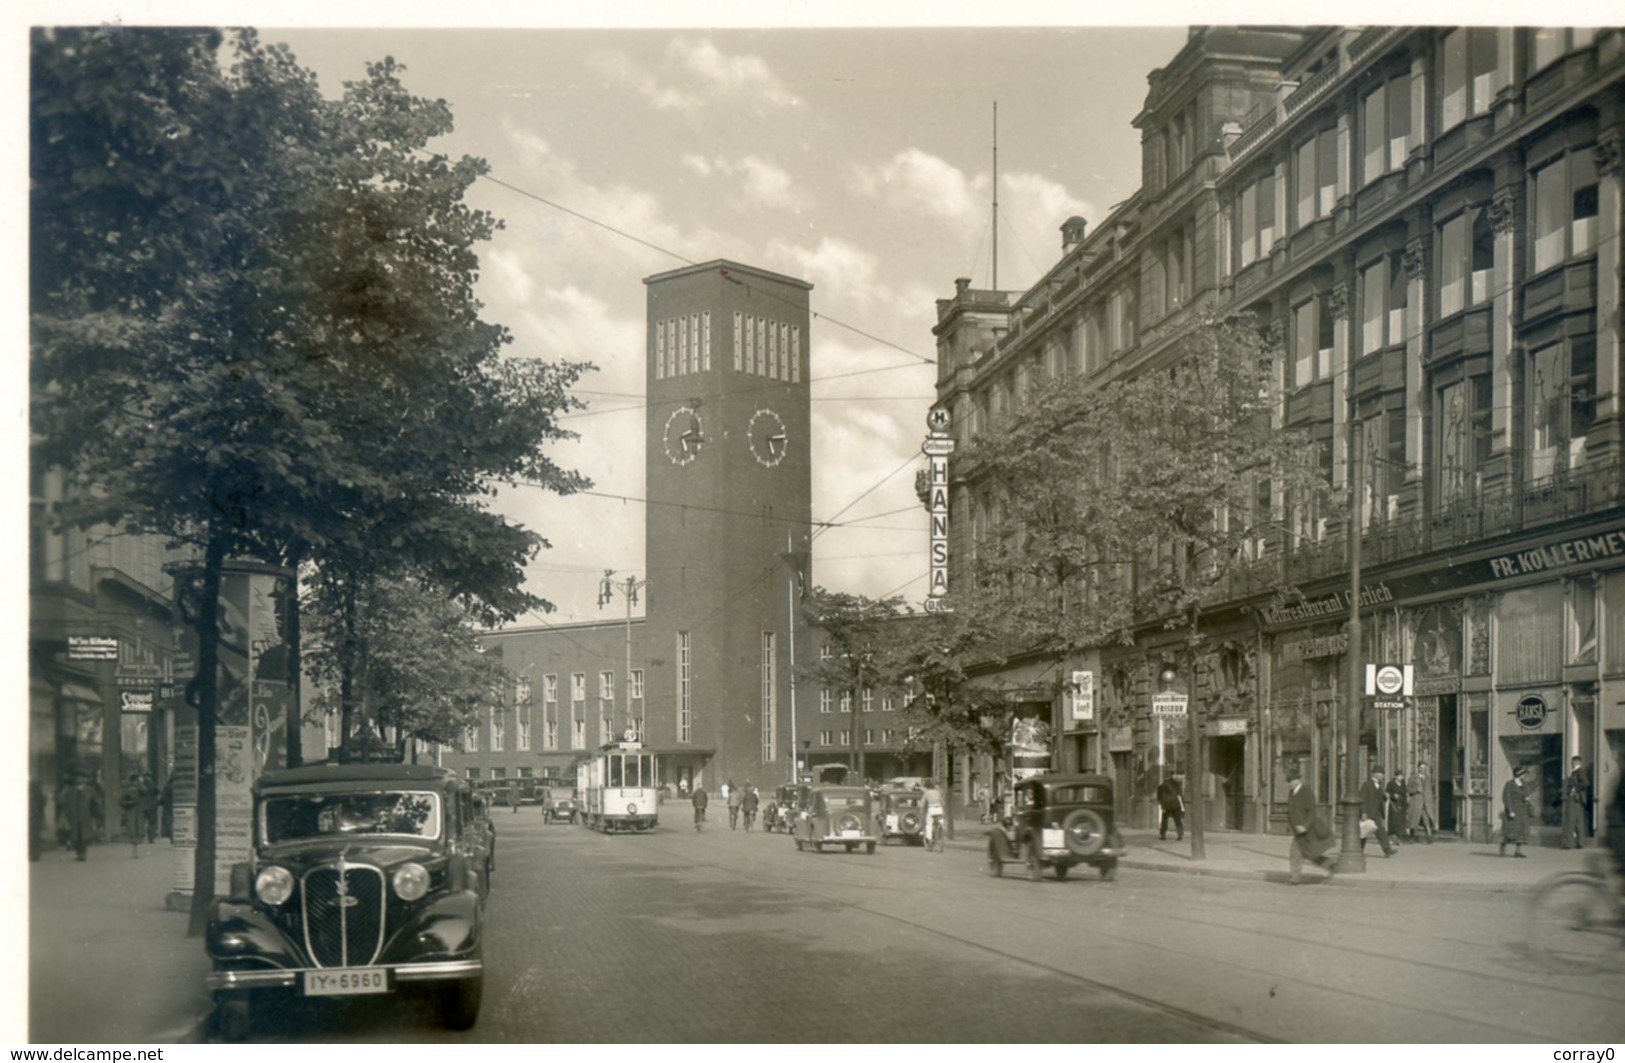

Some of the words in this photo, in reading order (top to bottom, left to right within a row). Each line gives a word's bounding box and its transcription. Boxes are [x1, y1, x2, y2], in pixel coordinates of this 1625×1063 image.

[934, 411, 945, 424] H
[933, 462, 947, 589] HANSA
[1261, 593, 1344, 624] Weinrestaurant
[1156, 705, 1184, 713] FRISEUR
[1518, 703, 1545, 720] HANSA
